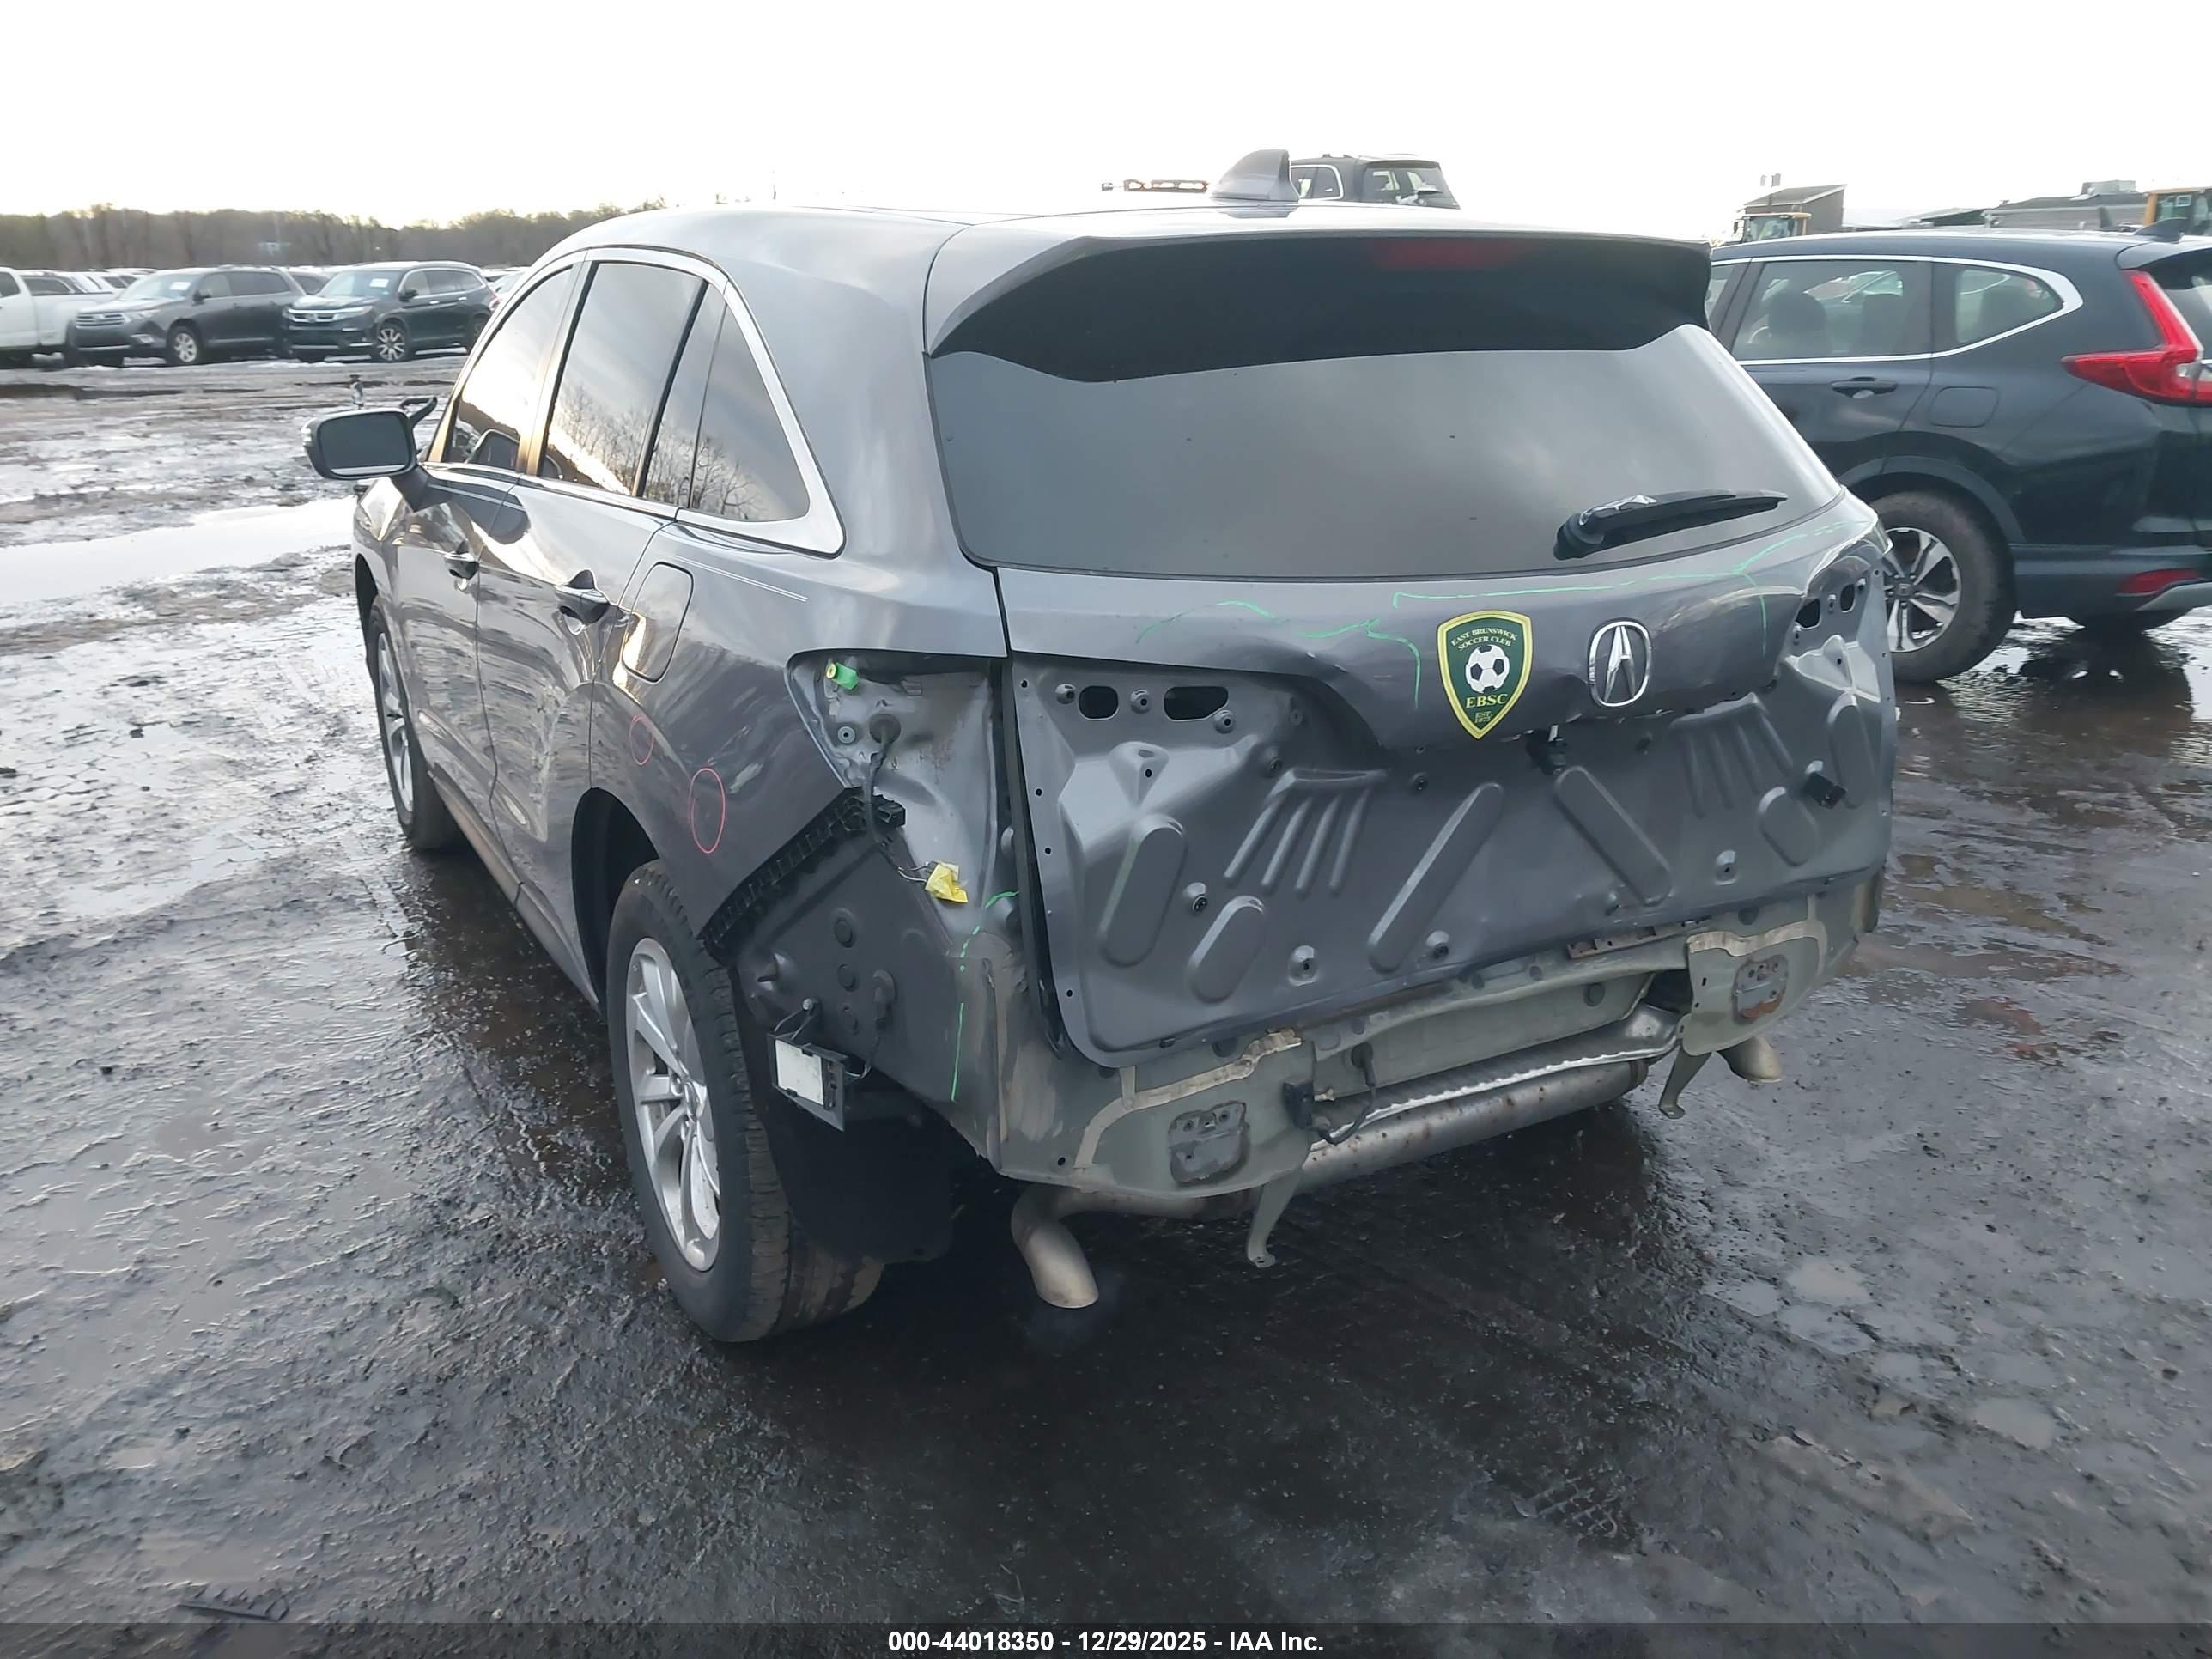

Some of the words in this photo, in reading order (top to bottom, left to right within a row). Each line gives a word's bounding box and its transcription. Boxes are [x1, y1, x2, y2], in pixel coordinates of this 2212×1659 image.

[1451, 631, 1470, 646] EAST
[1472, 628, 1517, 641] BRUNSWICK
[1458, 636, 1489, 650] SOCCER
[1490, 636, 1511, 646] CLUB
[1466, 693, 1508, 708] EBSC
